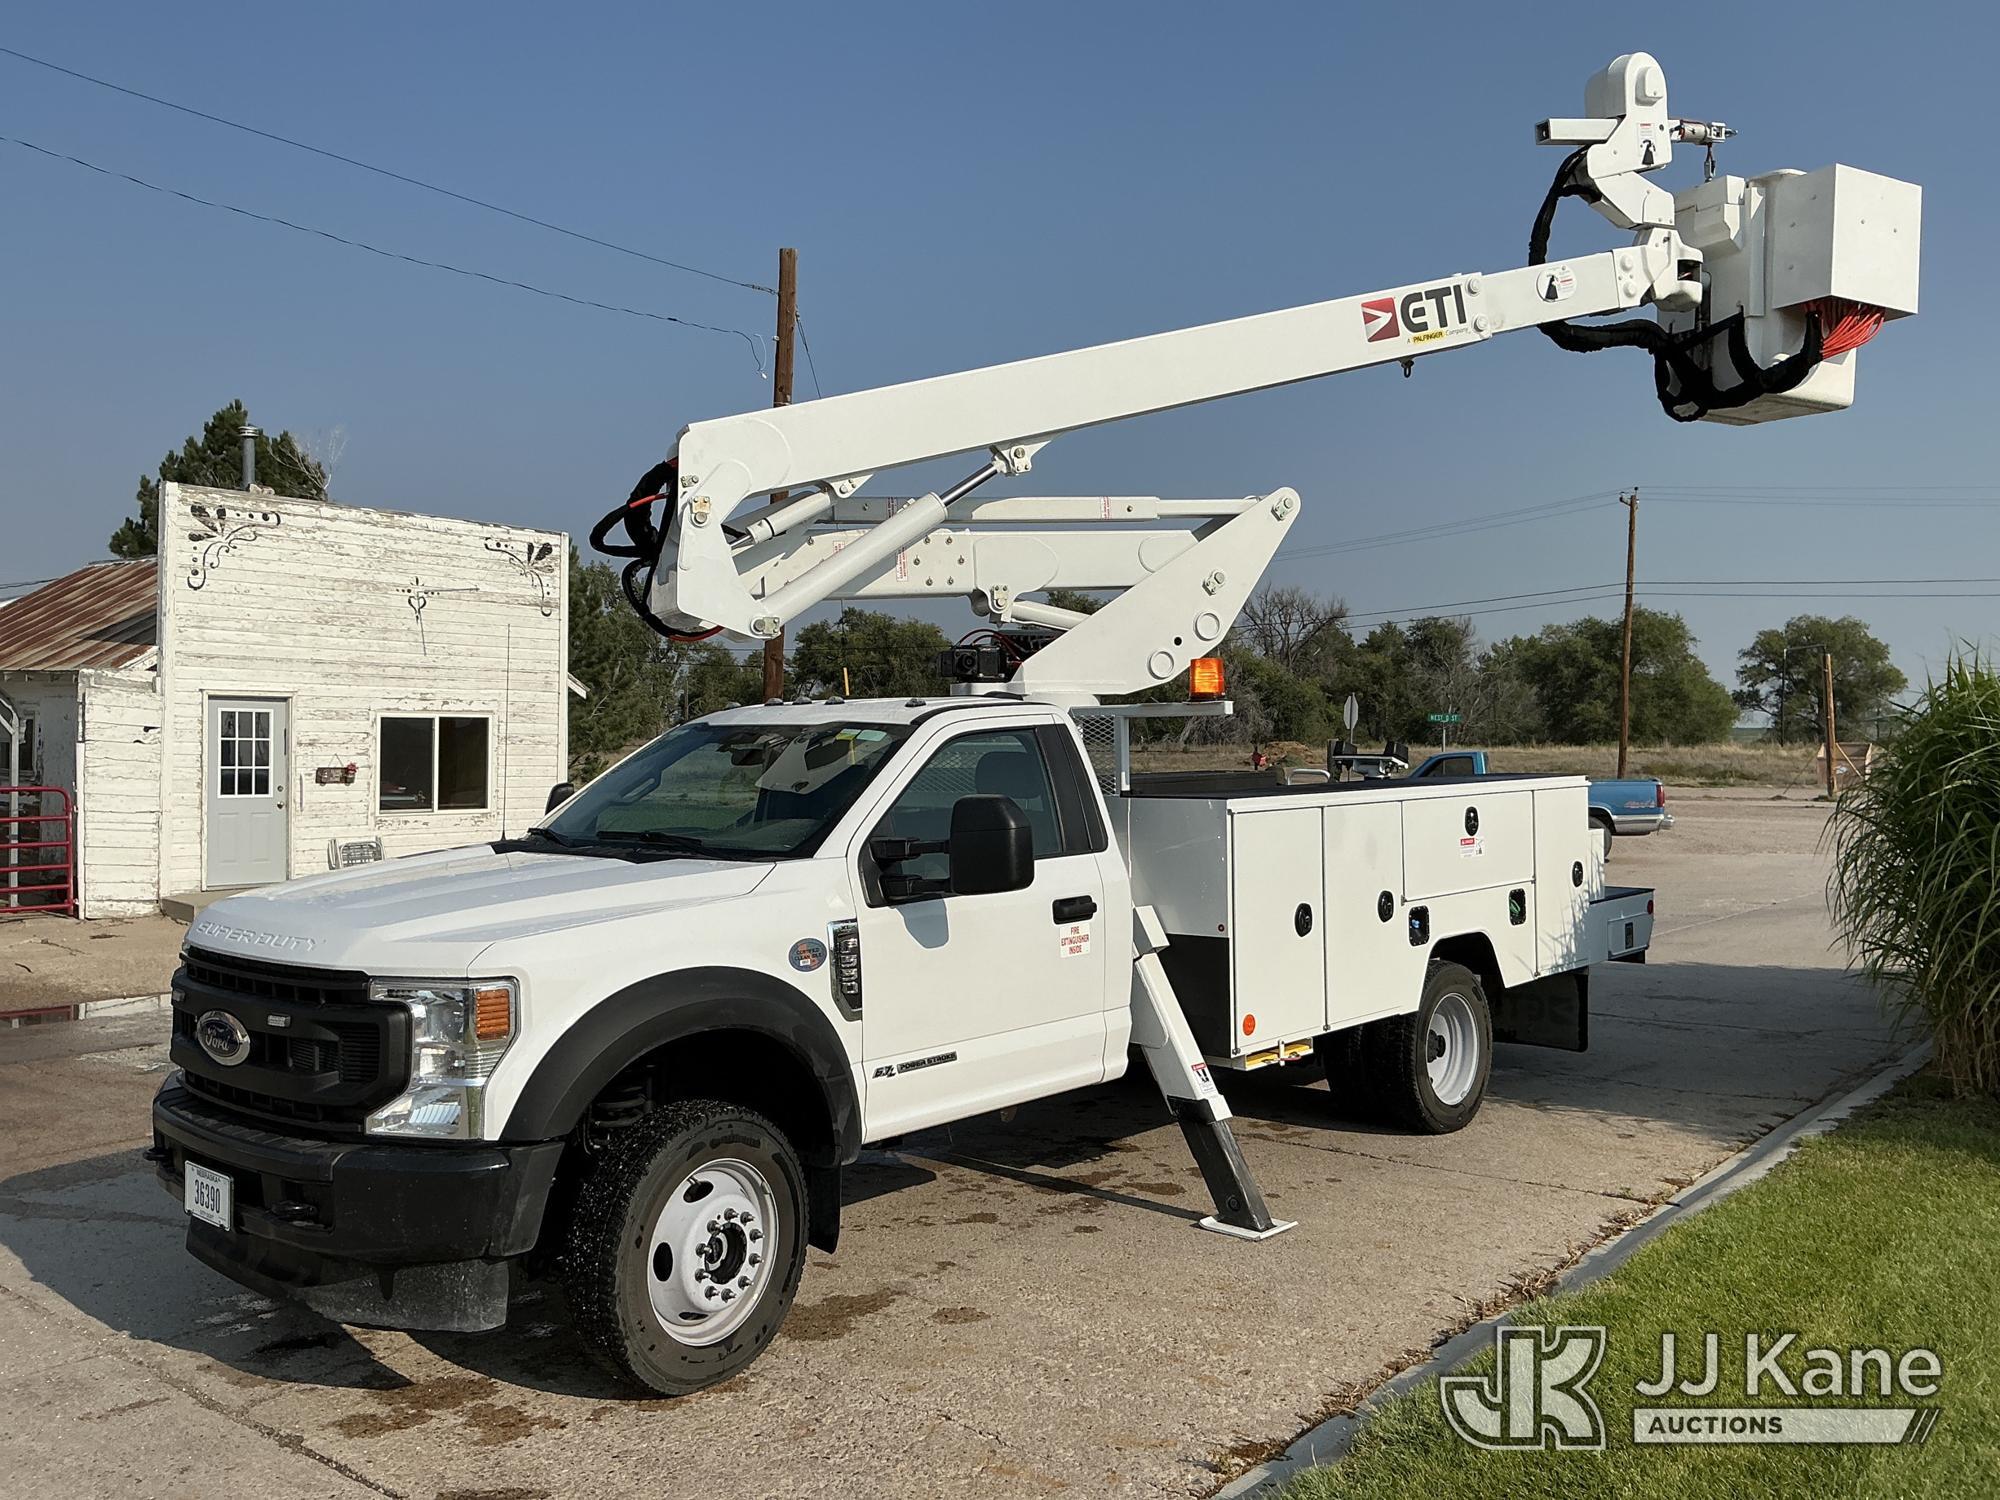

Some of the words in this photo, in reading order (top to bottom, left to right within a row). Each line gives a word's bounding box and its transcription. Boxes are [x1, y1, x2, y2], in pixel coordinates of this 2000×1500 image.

[1401, 284, 1467, 333] ETI
[1413, 331, 1443, 343] PALFINGER
[197, 921, 257, 944] SUPER
[255, 932, 316, 952] DUTY
[1061, 934, 1089, 946] EXTINGUISHER
[1071, 926, 1080, 935] FIRE
[1069, 945, 1082, 954] INSIDE
[205, 1027, 231, 1051] Ford
[899, 1058, 926, 1071] POWER
[926, 1052, 957, 1065] STROKE
[194, 1179, 221, 1214] 36390
